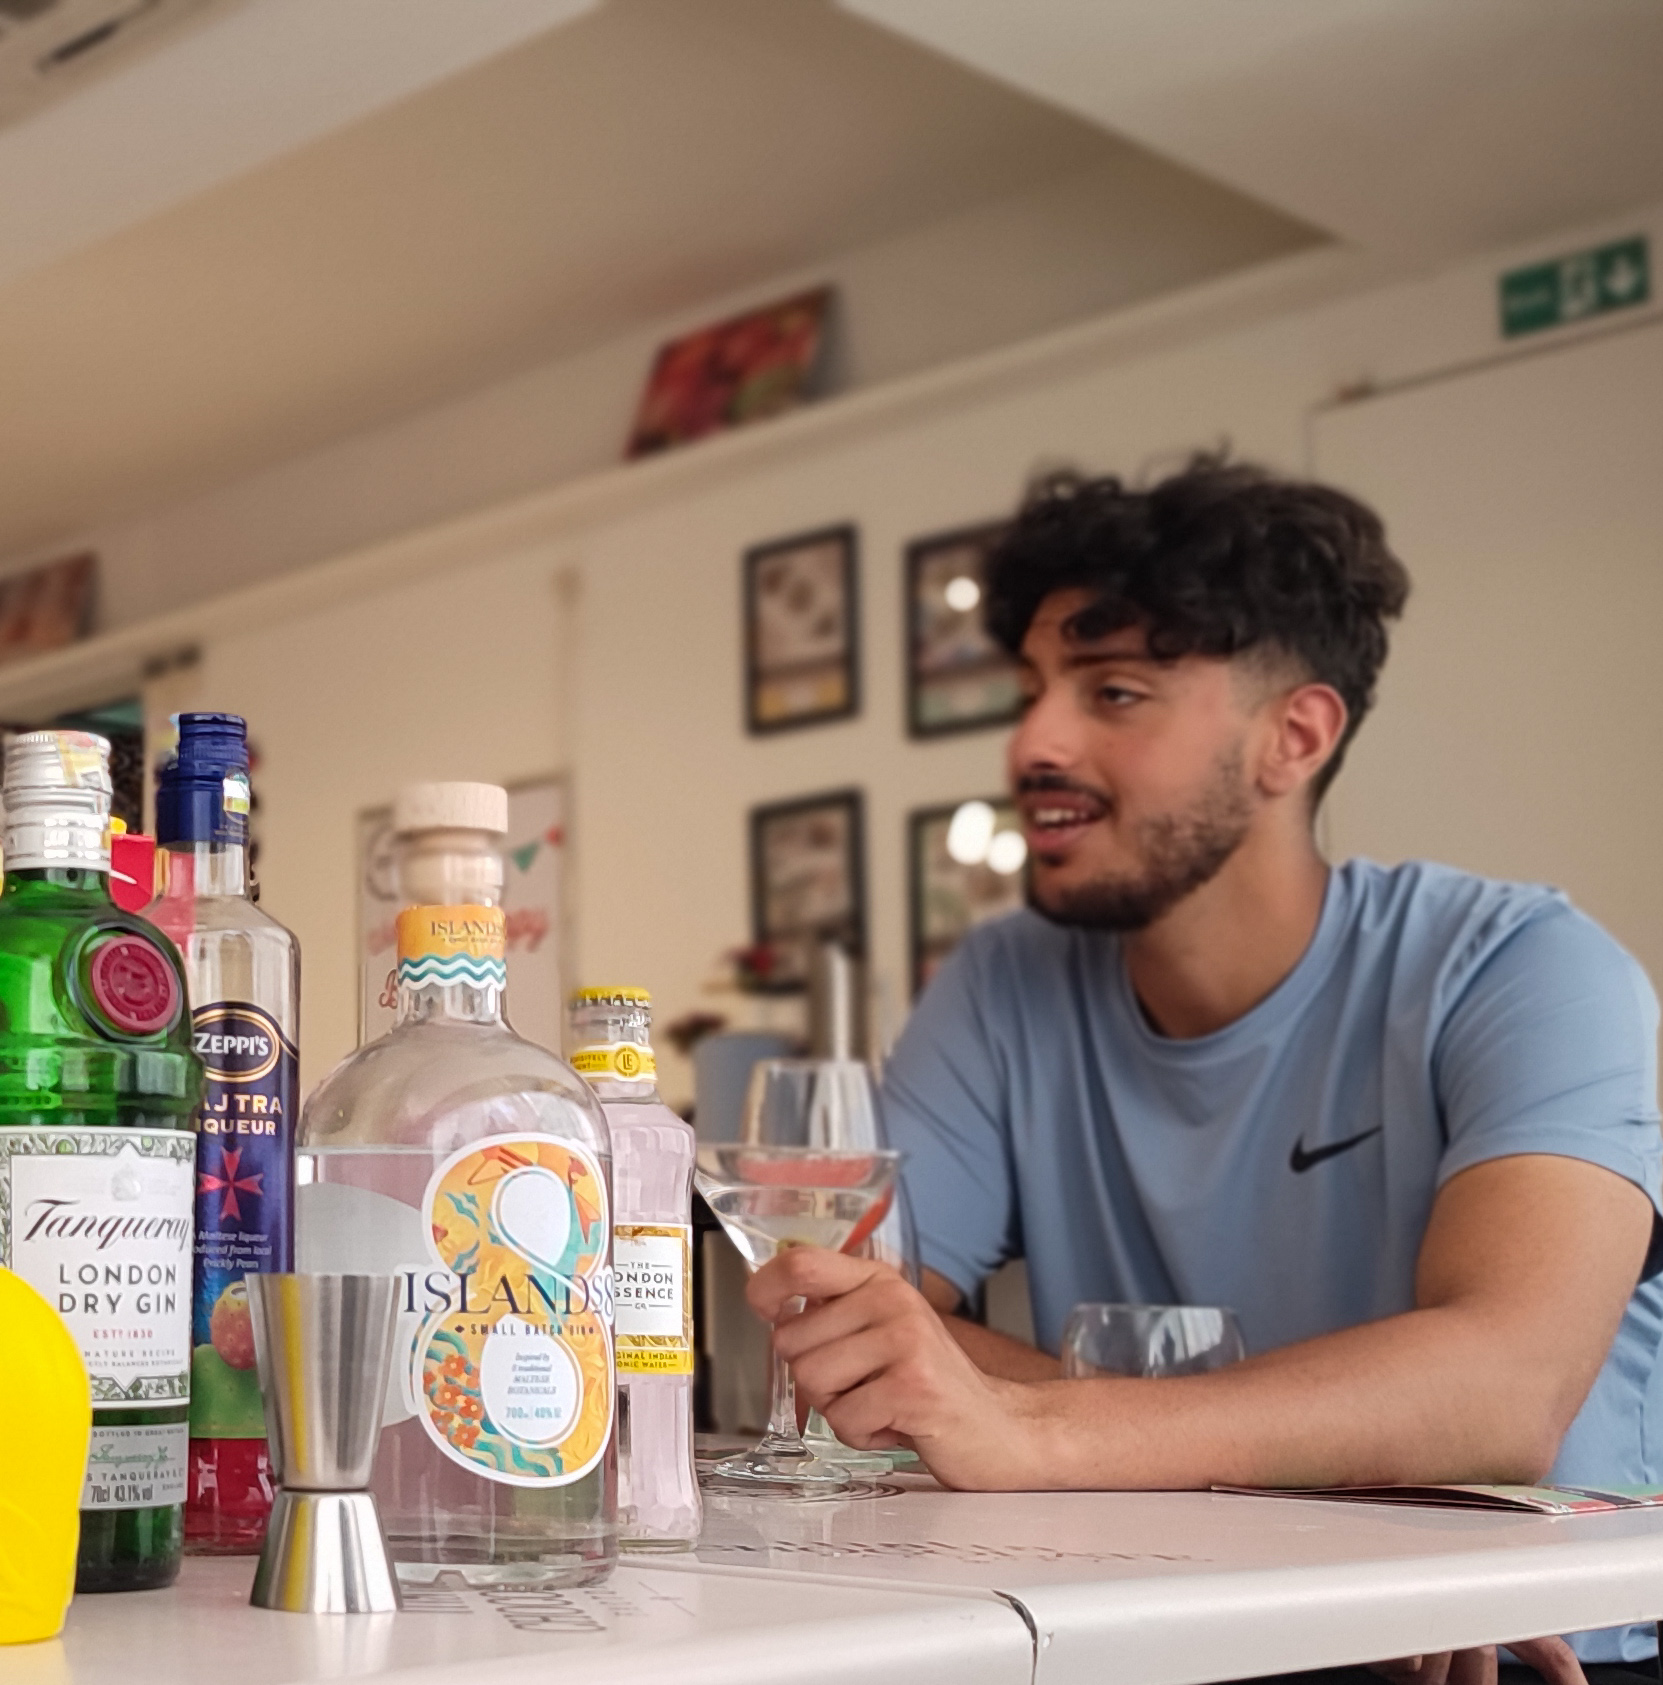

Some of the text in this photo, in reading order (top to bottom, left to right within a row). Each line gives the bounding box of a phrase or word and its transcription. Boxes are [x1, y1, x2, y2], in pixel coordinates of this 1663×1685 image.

[193, 1032, 269, 1056] ZEPPI'S
[196, 1118, 276, 1135] IQUEUR
[23, 1199, 189, 1251] Tanqueray
[59, 1264, 176, 1285] LONDON
[615, 1272, 673, 1285] ONDON
[614, 1287, 673, 1300] SSENCE
[59, 1293, 176, 1314] DRY GIN
[127, 1329, 153, 1339] 1830
[471, 1324, 516, 1335] SMALL
[525, 1323, 563, 1335] BATCH
[85, 1350, 134, 1358] NATURE
[617, 1351, 677, 1360] GINAL INDIAN
